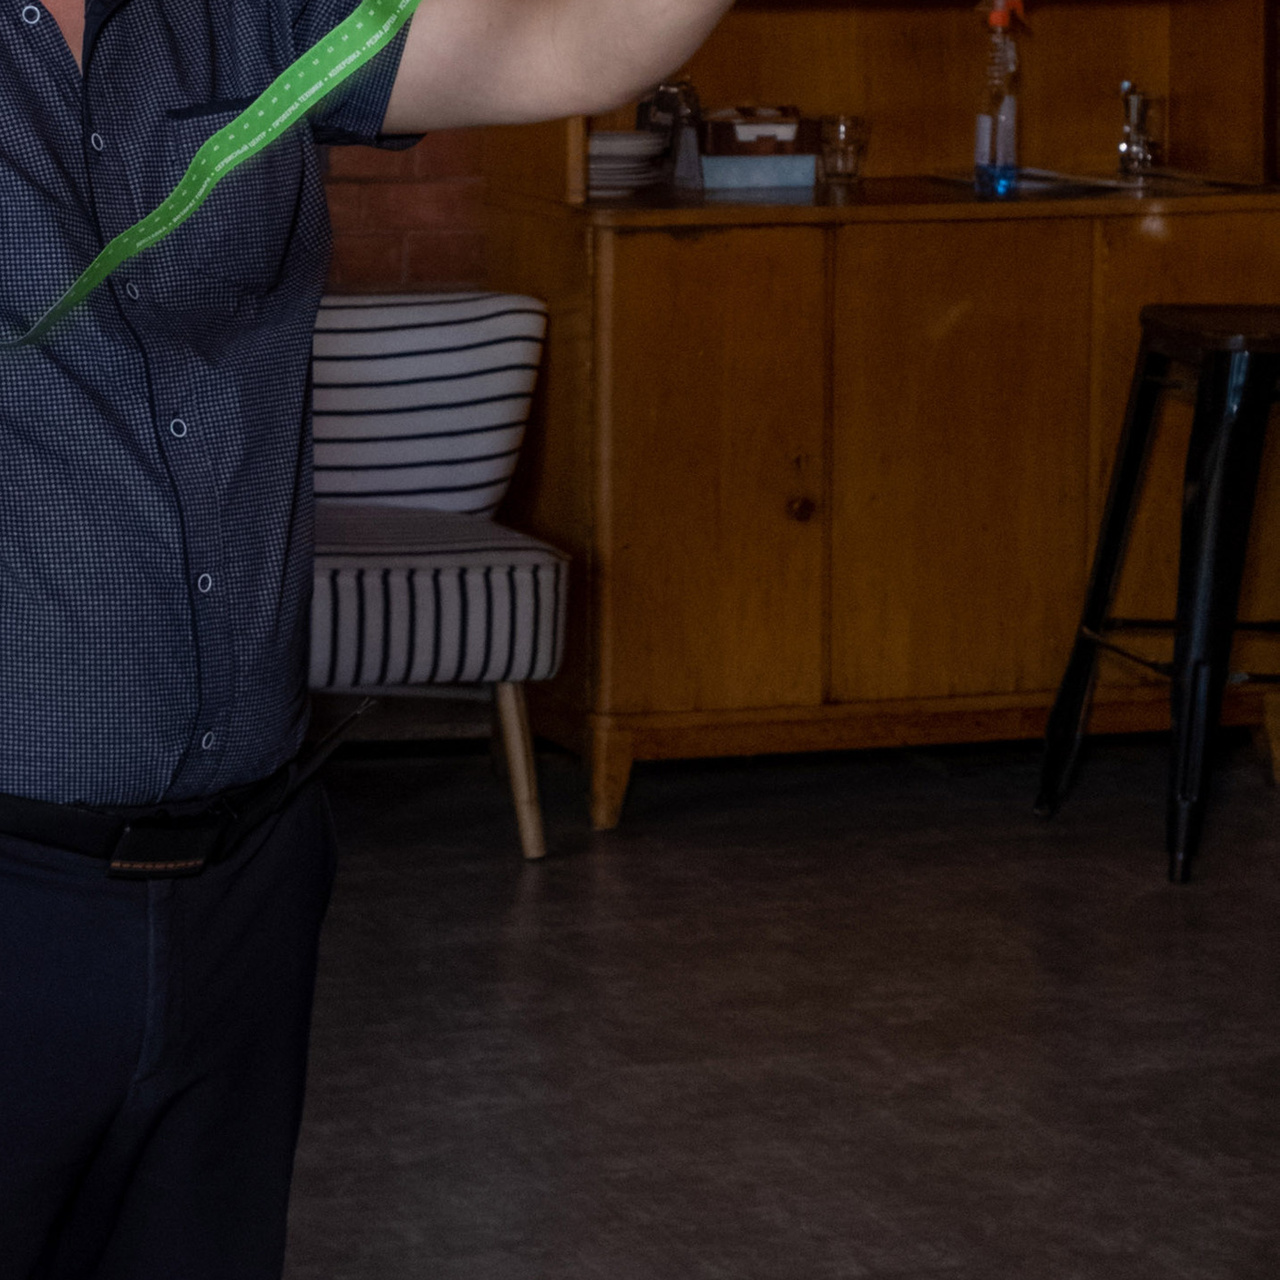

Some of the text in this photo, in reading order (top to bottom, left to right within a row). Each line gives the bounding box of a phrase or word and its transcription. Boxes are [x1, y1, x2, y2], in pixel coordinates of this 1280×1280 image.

[271, 103, 301, 129] ПРОВЕРКА
[328, 50, 362, 78] КОЛЕРОВКА
[366, 30, 384, 48] РЕЗКА
